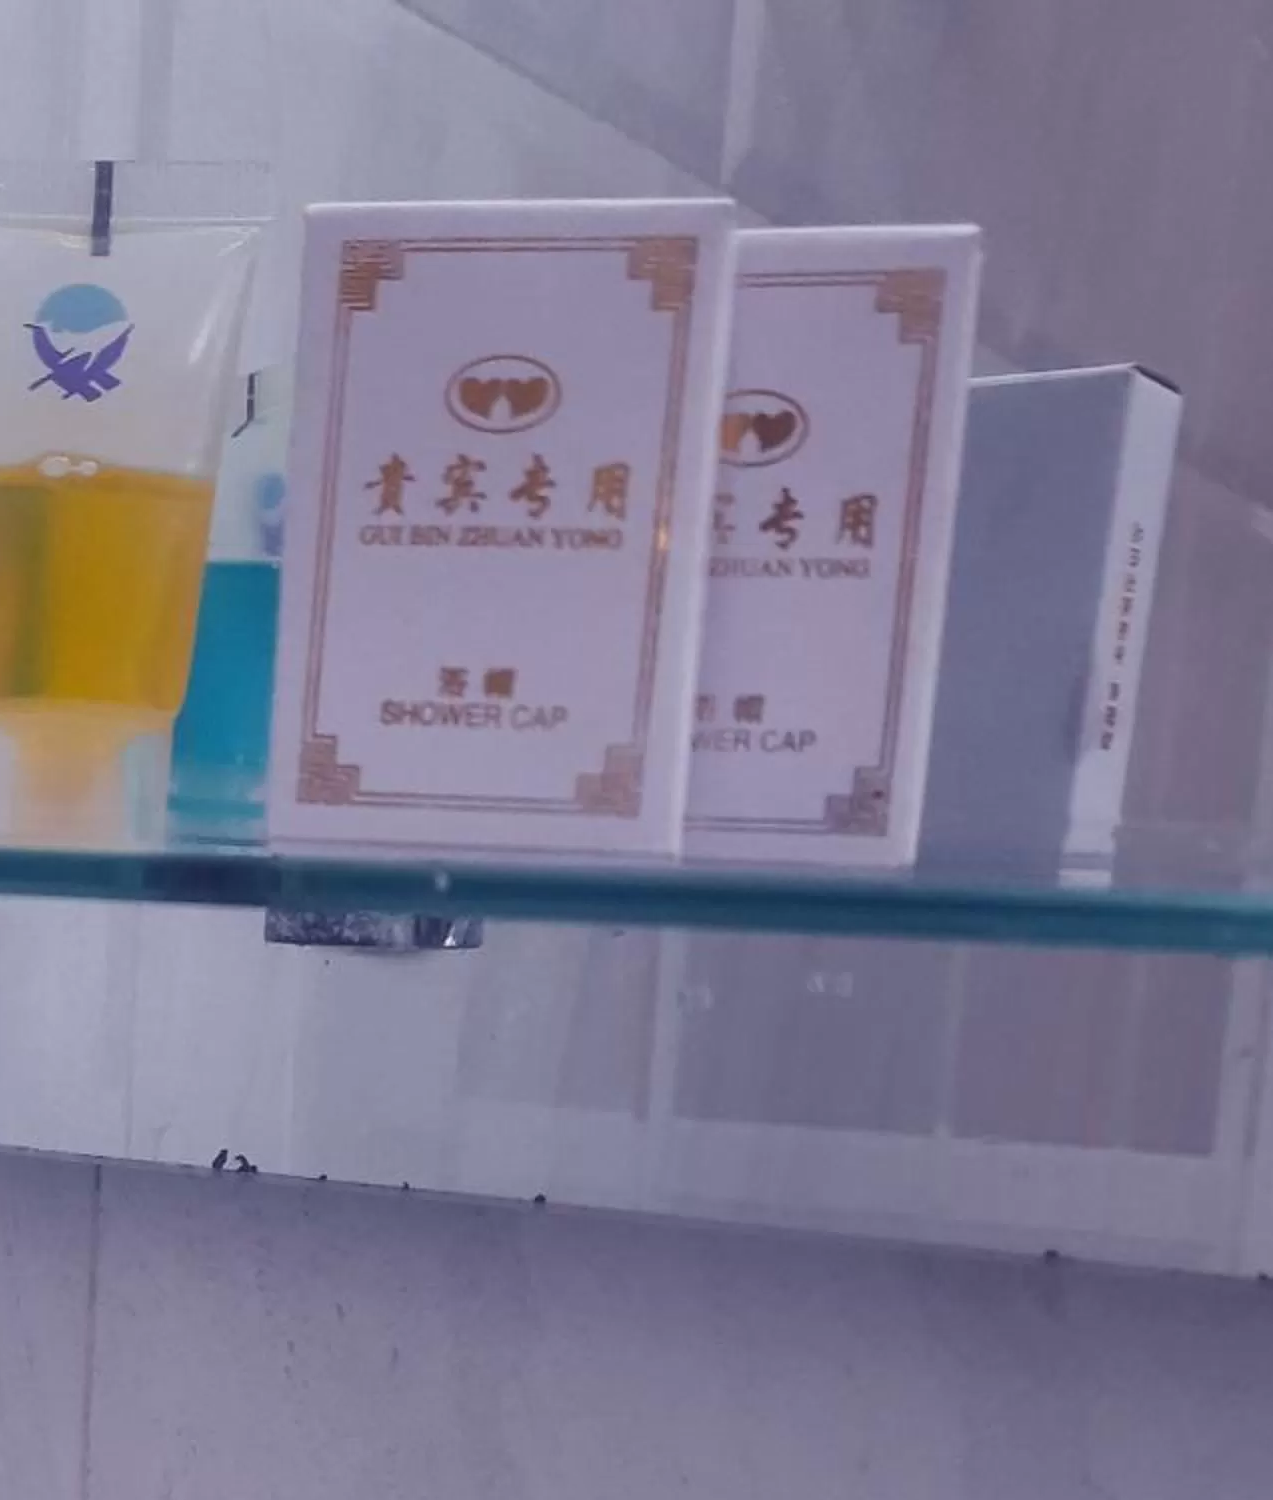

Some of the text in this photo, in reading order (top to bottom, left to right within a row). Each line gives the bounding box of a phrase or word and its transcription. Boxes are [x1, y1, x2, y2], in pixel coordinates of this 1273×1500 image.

[378, 698, 571, 732] SHOWER CAP
[758, 728, 818, 754] CAP
